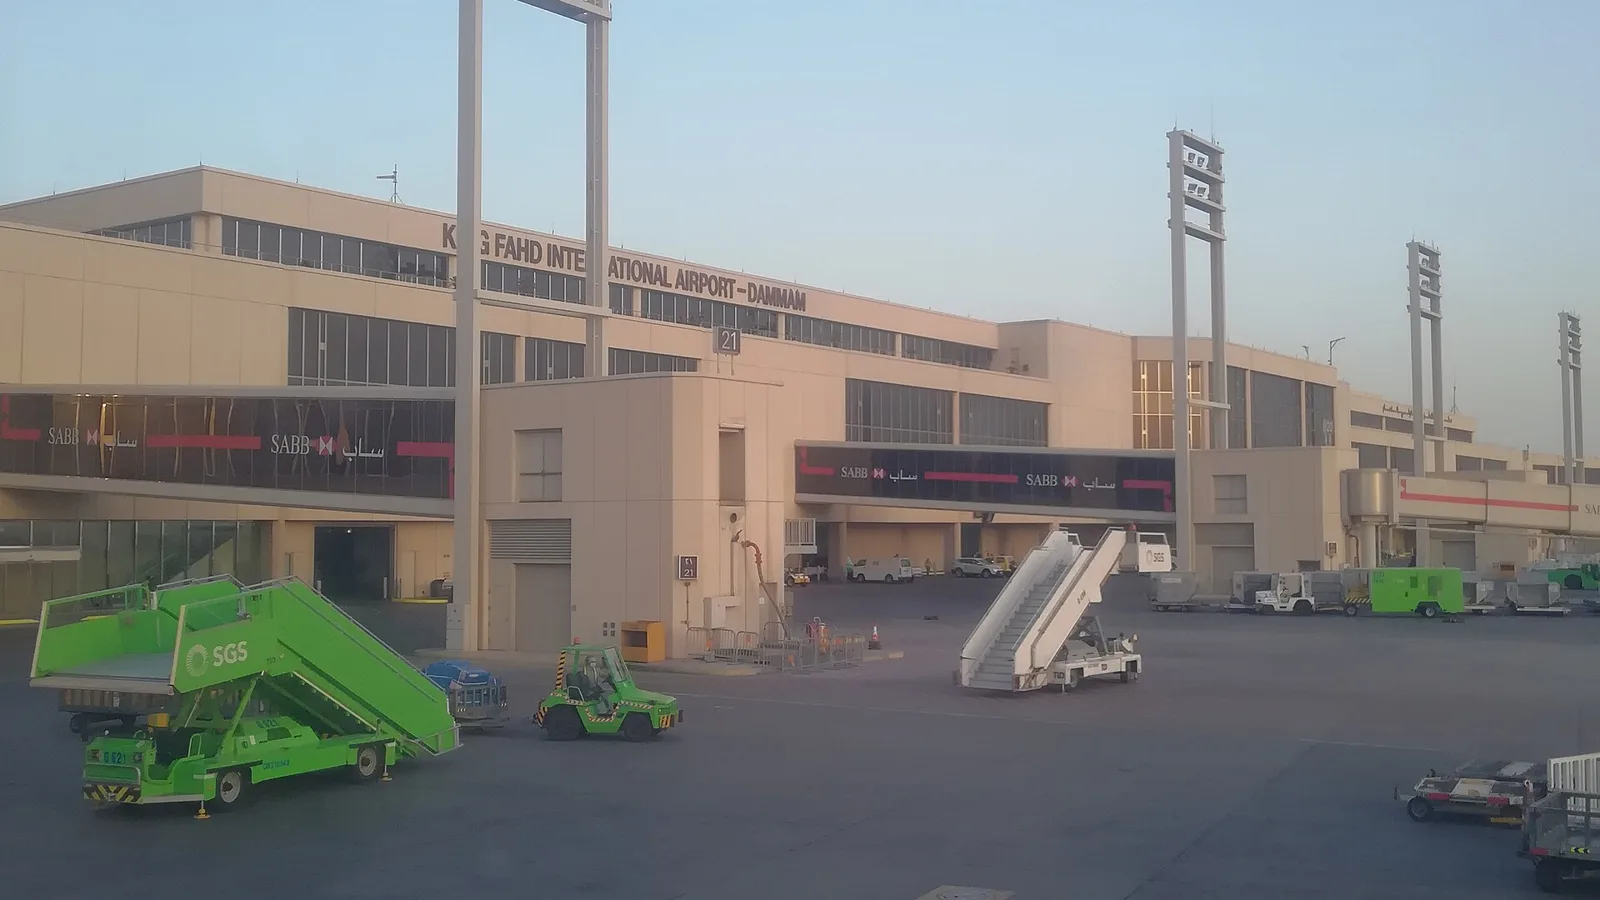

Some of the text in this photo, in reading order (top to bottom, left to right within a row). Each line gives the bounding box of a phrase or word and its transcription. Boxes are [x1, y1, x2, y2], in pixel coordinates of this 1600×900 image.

[443, 223, 489, 255] KG
[495, 233, 542, 264] FAHD
[547, 243, 672, 288] INTEATIONAL
[675, 269, 736, 298] AIRPORT
[748, 282, 806, 311] DAMMAM
[722, 331, 736, 350] 21
[48, 427, 79, 445] SABB
[270, 434, 310, 455] SABB
[342, 437, 384, 462] ساب
[841, 466, 868, 478] SABB
[889, 469, 918, 482] ساب
[1026, 473, 1058, 486] SABB
[1082, 477, 1116, 491] ساب
[1584, 503, 1600, 515] SA
[1153, 552, 1165, 563] SGS
[684, 569, 694, 577] 21
[213, 640, 248, 667] SGS
